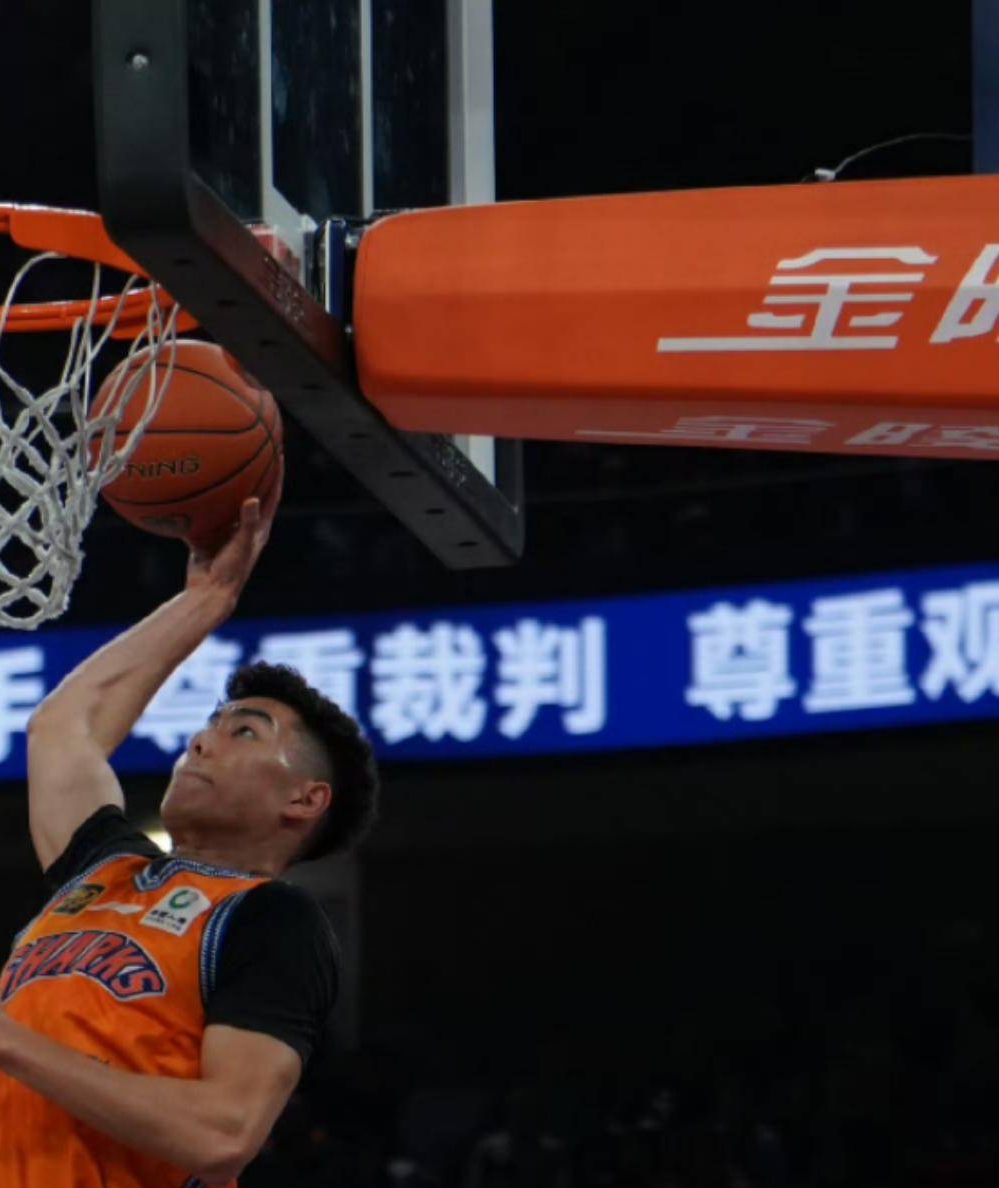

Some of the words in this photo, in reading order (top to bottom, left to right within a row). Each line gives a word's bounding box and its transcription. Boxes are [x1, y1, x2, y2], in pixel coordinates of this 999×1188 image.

[657, 243, 999, 352] 金
[685, 580, 999, 722] 尊重观
